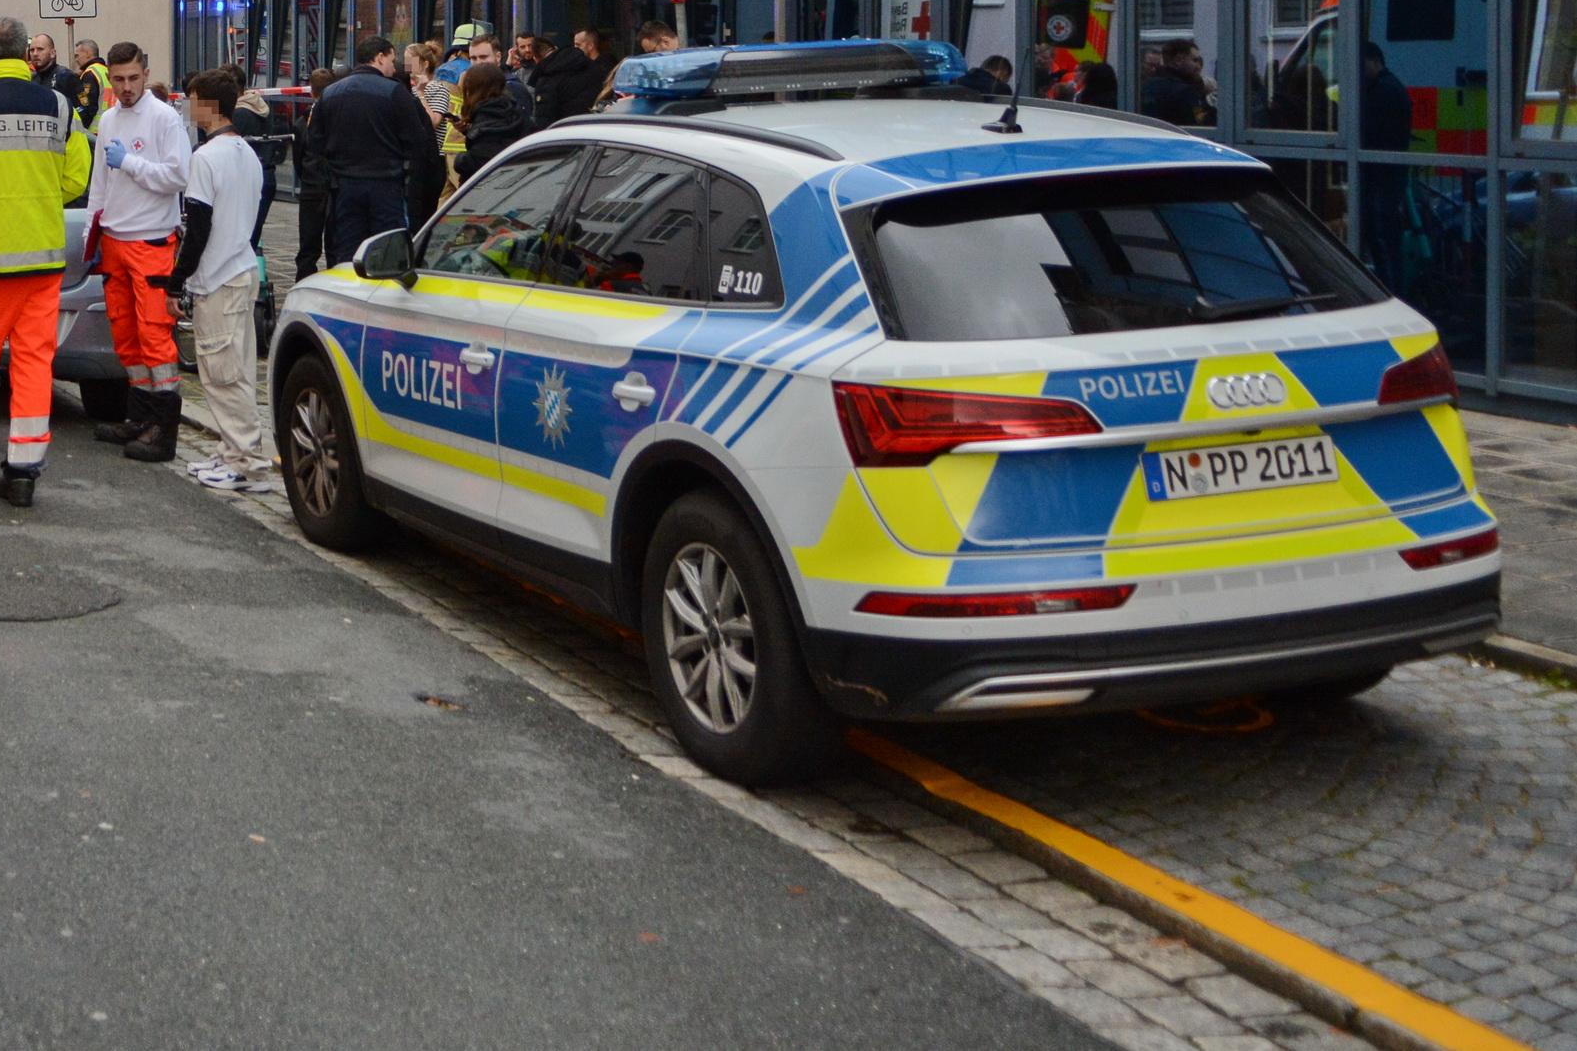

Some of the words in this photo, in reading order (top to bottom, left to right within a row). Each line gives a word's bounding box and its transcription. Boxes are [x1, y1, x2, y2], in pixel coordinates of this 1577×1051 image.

[17, 119, 58, 134] LEITER
[734, 270, 763, 295] 110
[382, 350, 462, 410] POLIZEI
[1079, 370, 1184, 401] POLIZEI
[1164, 455, 1190, 492] N
[1207, 450, 1248, 487] PP
[1256, 441, 1333, 482] 2011
